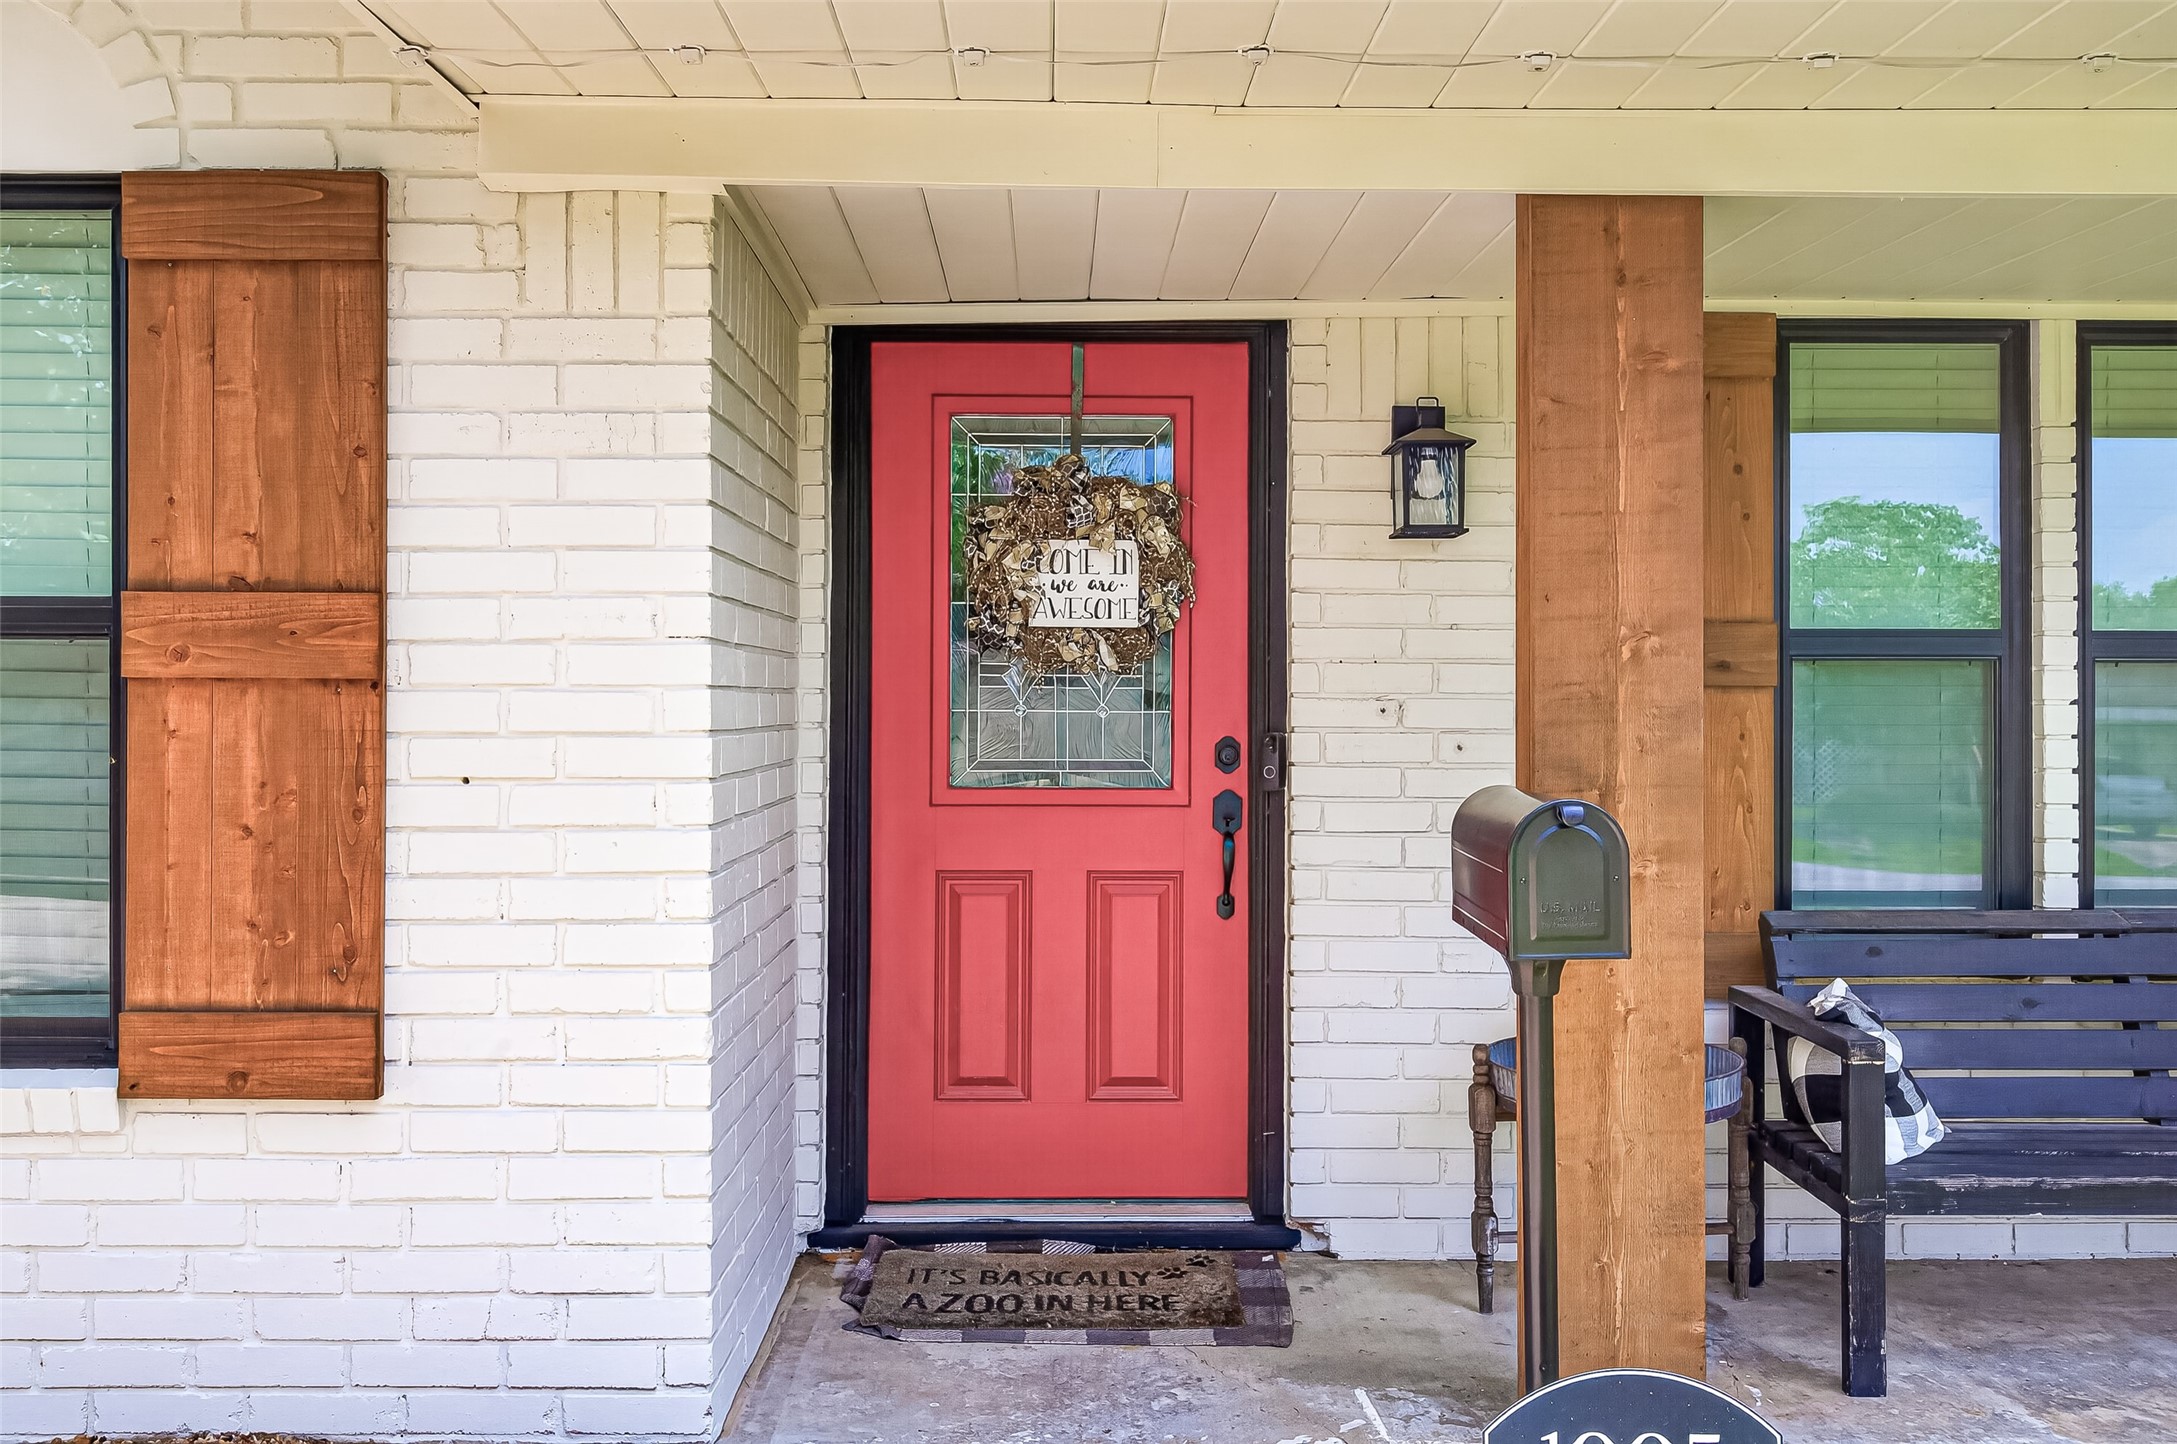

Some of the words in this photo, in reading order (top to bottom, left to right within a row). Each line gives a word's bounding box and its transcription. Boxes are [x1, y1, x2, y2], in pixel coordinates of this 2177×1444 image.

[1036, 548, 1101, 575] COME
[1109, 548, 1133, 575] IN
[1050, 579, 1078, 594] we
[1087, 579, 1119, 593] are
[1033, 597, 1137, 620] AWESOME
[907, 1268, 967, 1285] IT'S
[979, 1269, 1151, 1287] BASICALLY
[902, 1292, 928, 1310] A
[933, 1292, 1024, 1314] ZOO
[1033, 1294, 1073, 1312] IN
[1086, 1294, 1181, 1313] HERE
